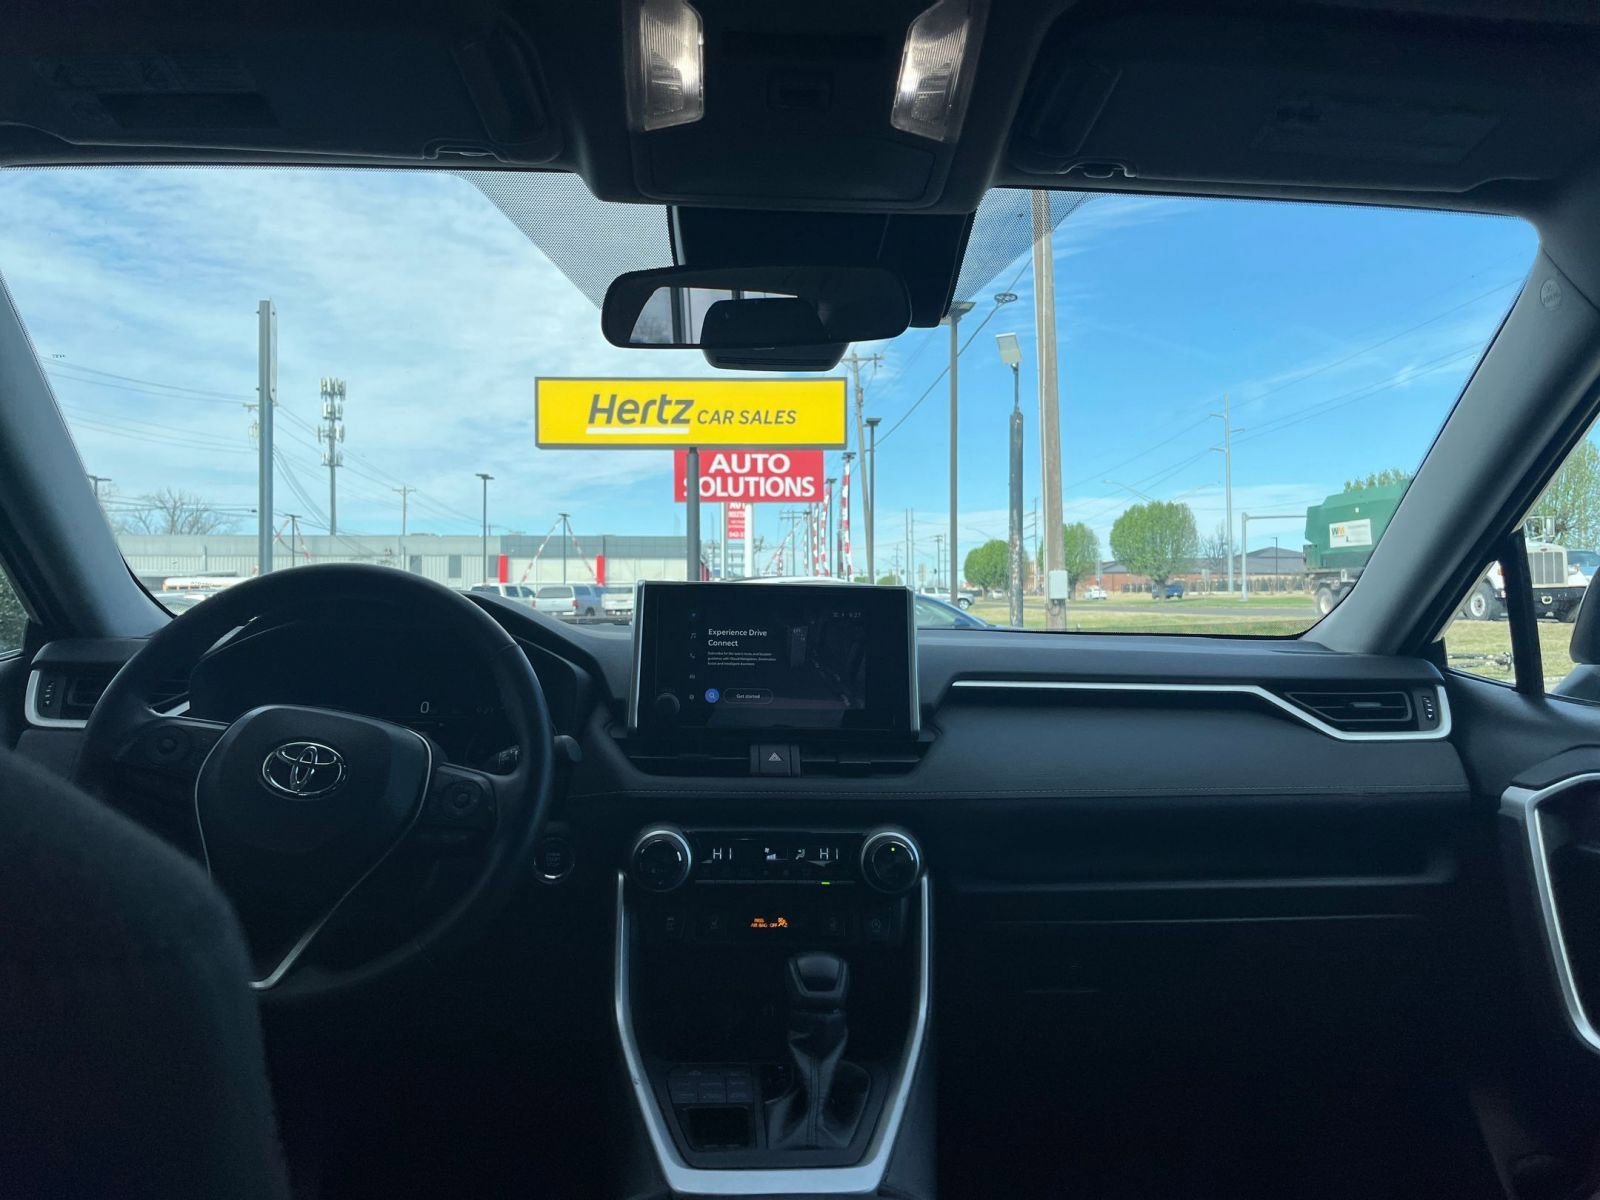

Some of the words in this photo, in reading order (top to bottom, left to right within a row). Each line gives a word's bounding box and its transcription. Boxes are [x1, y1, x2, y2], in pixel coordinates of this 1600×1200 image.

[588, 394, 695, 425] Hertz
[697, 410, 735, 425] CAR
[738, 410, 797, 425] SALES
[708, 453, 791, 474] AUTO
[708, 629, 747, 637] Experience
[748, 629, 768, 637] Drive
[707, 639, 739, 647] Connect
